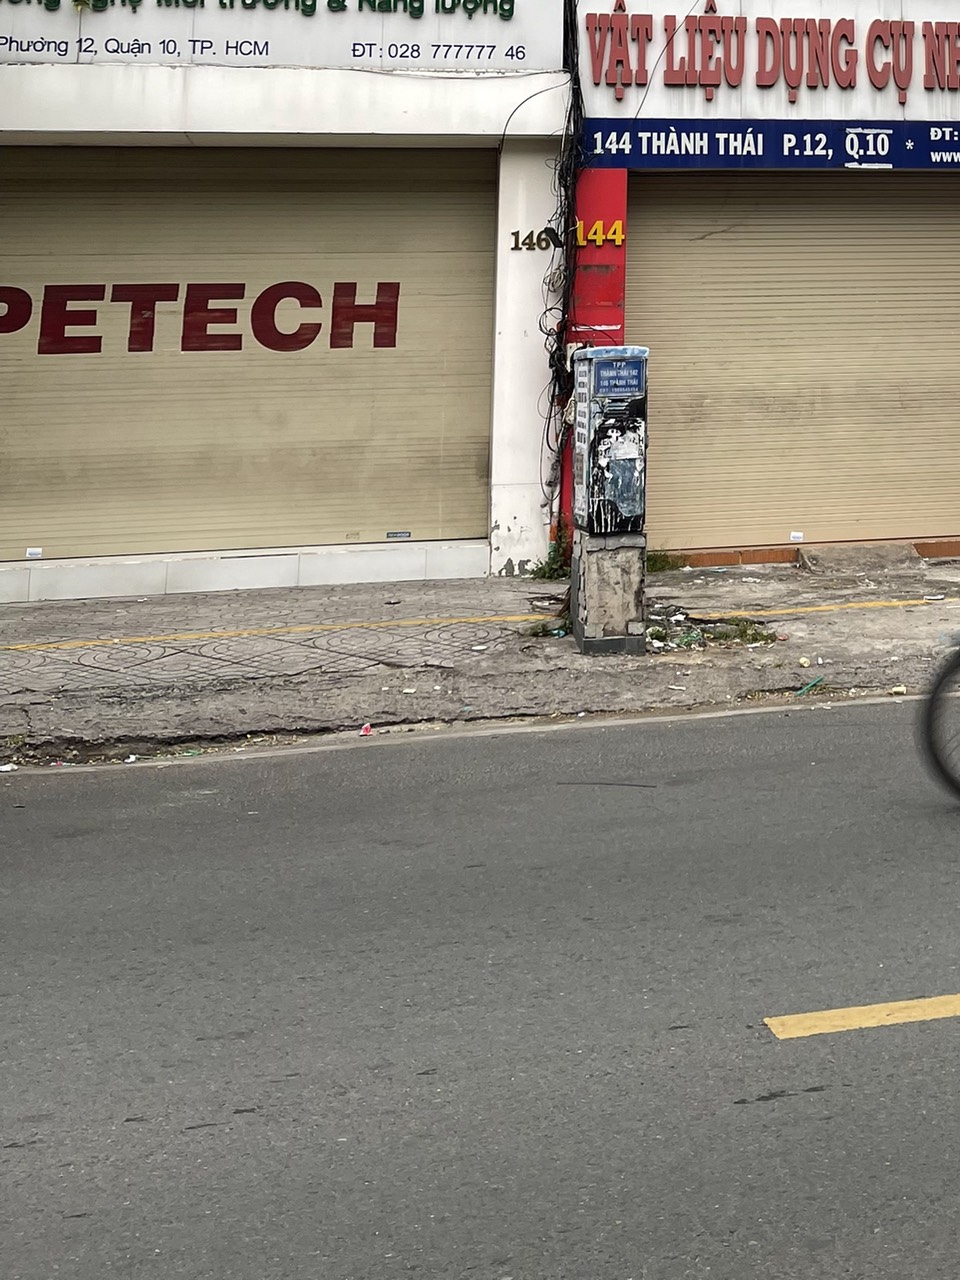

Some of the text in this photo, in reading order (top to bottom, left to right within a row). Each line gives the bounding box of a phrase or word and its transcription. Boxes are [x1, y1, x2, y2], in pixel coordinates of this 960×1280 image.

[0, 35, 269, 57] Phường 12, Quận 10, TP. HCM
[387, 43, 420, 58] 028
[431, 44, 496, 59] 777777
[505, 45, 526, 60] 46
[756, 17, 858, 104] DỤNG
[866, 19, 915, 104] CỤ
[593, 131, 632, 155] 144
[638, 126, 709, 156] THÀNH
[715, 128, 764, 156] THÁI
[844, 131, 890, 160] Q.10
[930, 127, 959, 140] ĐT:
[511, 230, 551, 251] 146
[577, 220, 625, 247] 144
